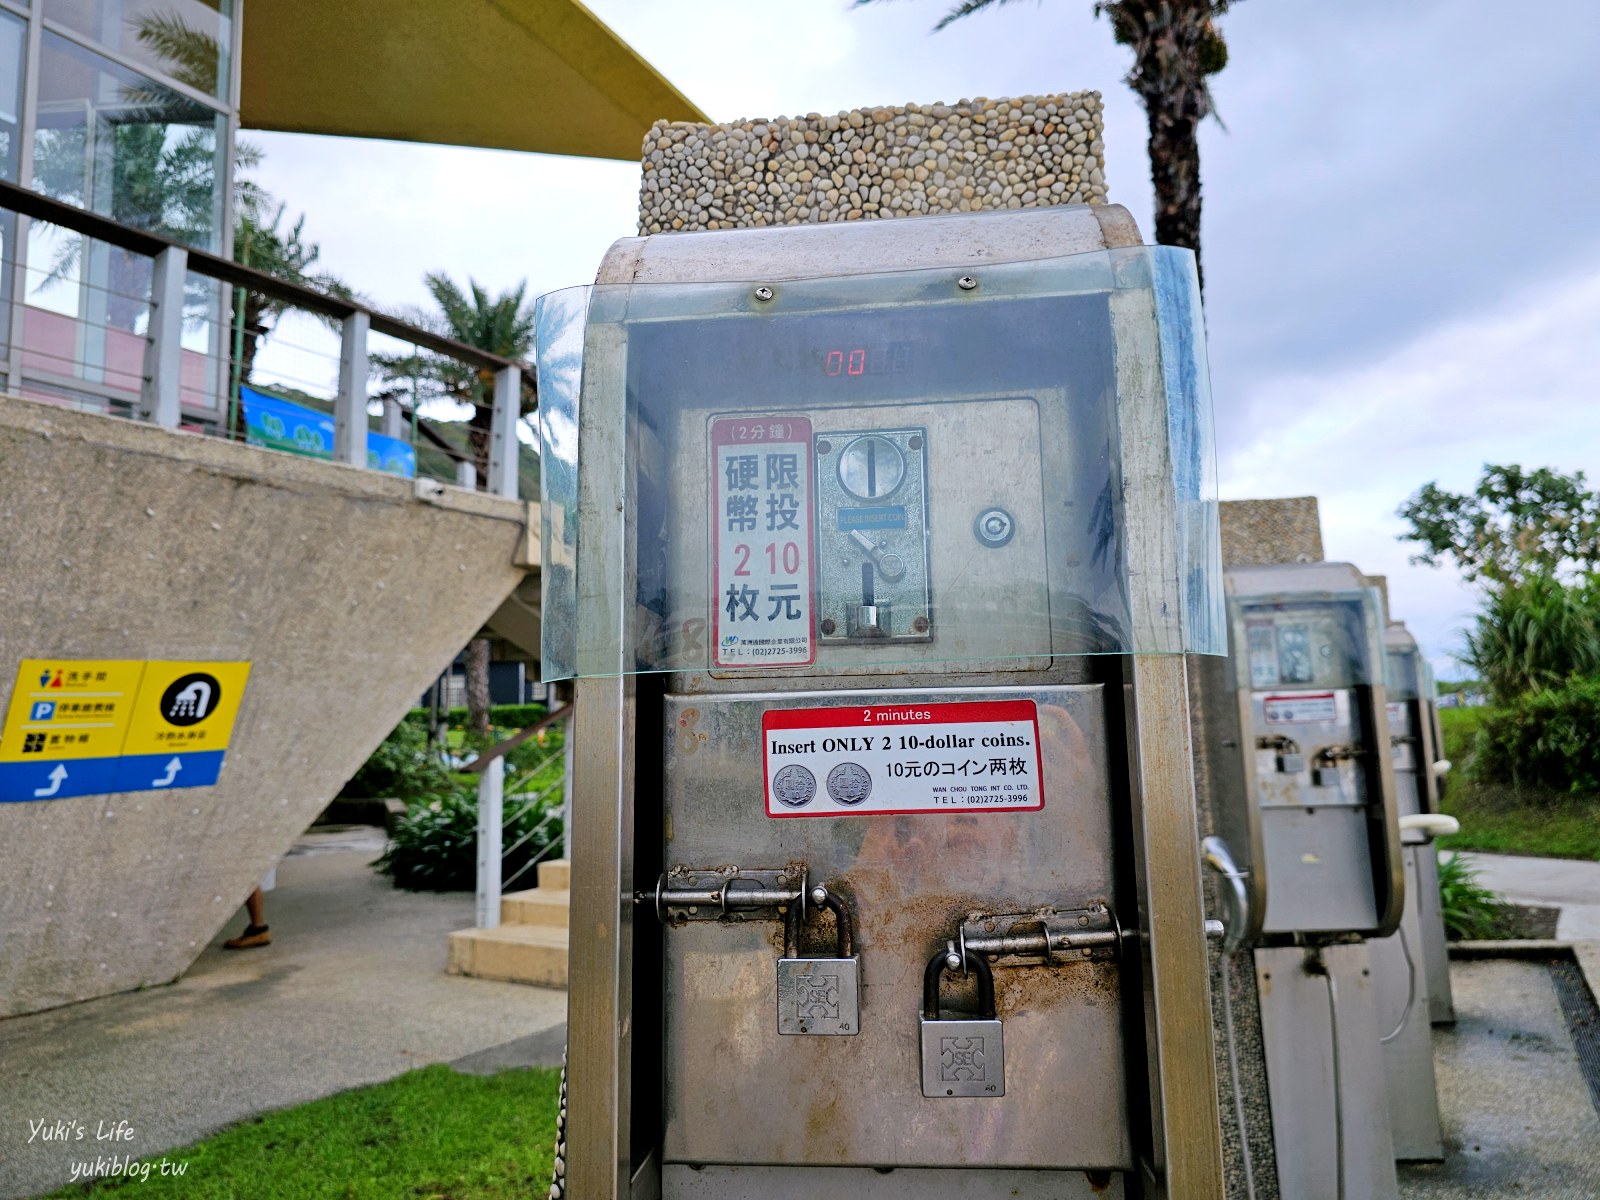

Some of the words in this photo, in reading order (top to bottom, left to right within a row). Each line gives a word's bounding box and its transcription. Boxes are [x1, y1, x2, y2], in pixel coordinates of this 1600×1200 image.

[731, 424, 793, 440] (2分鐘)
[863, 709, 872, 722] 2
[876, 708, 931, 721] minutes
[772, 740, 816, 754] Insert
[822, 737, 874, 752] ONLY
[882, 737, 892, 750] 2
[899, 734, 975, 749] 10-dollar
[981, 733, 1030, 747] coins.
[839, 1023, 850, 1031] 40
[985, 1084, 997, 1092] 40
